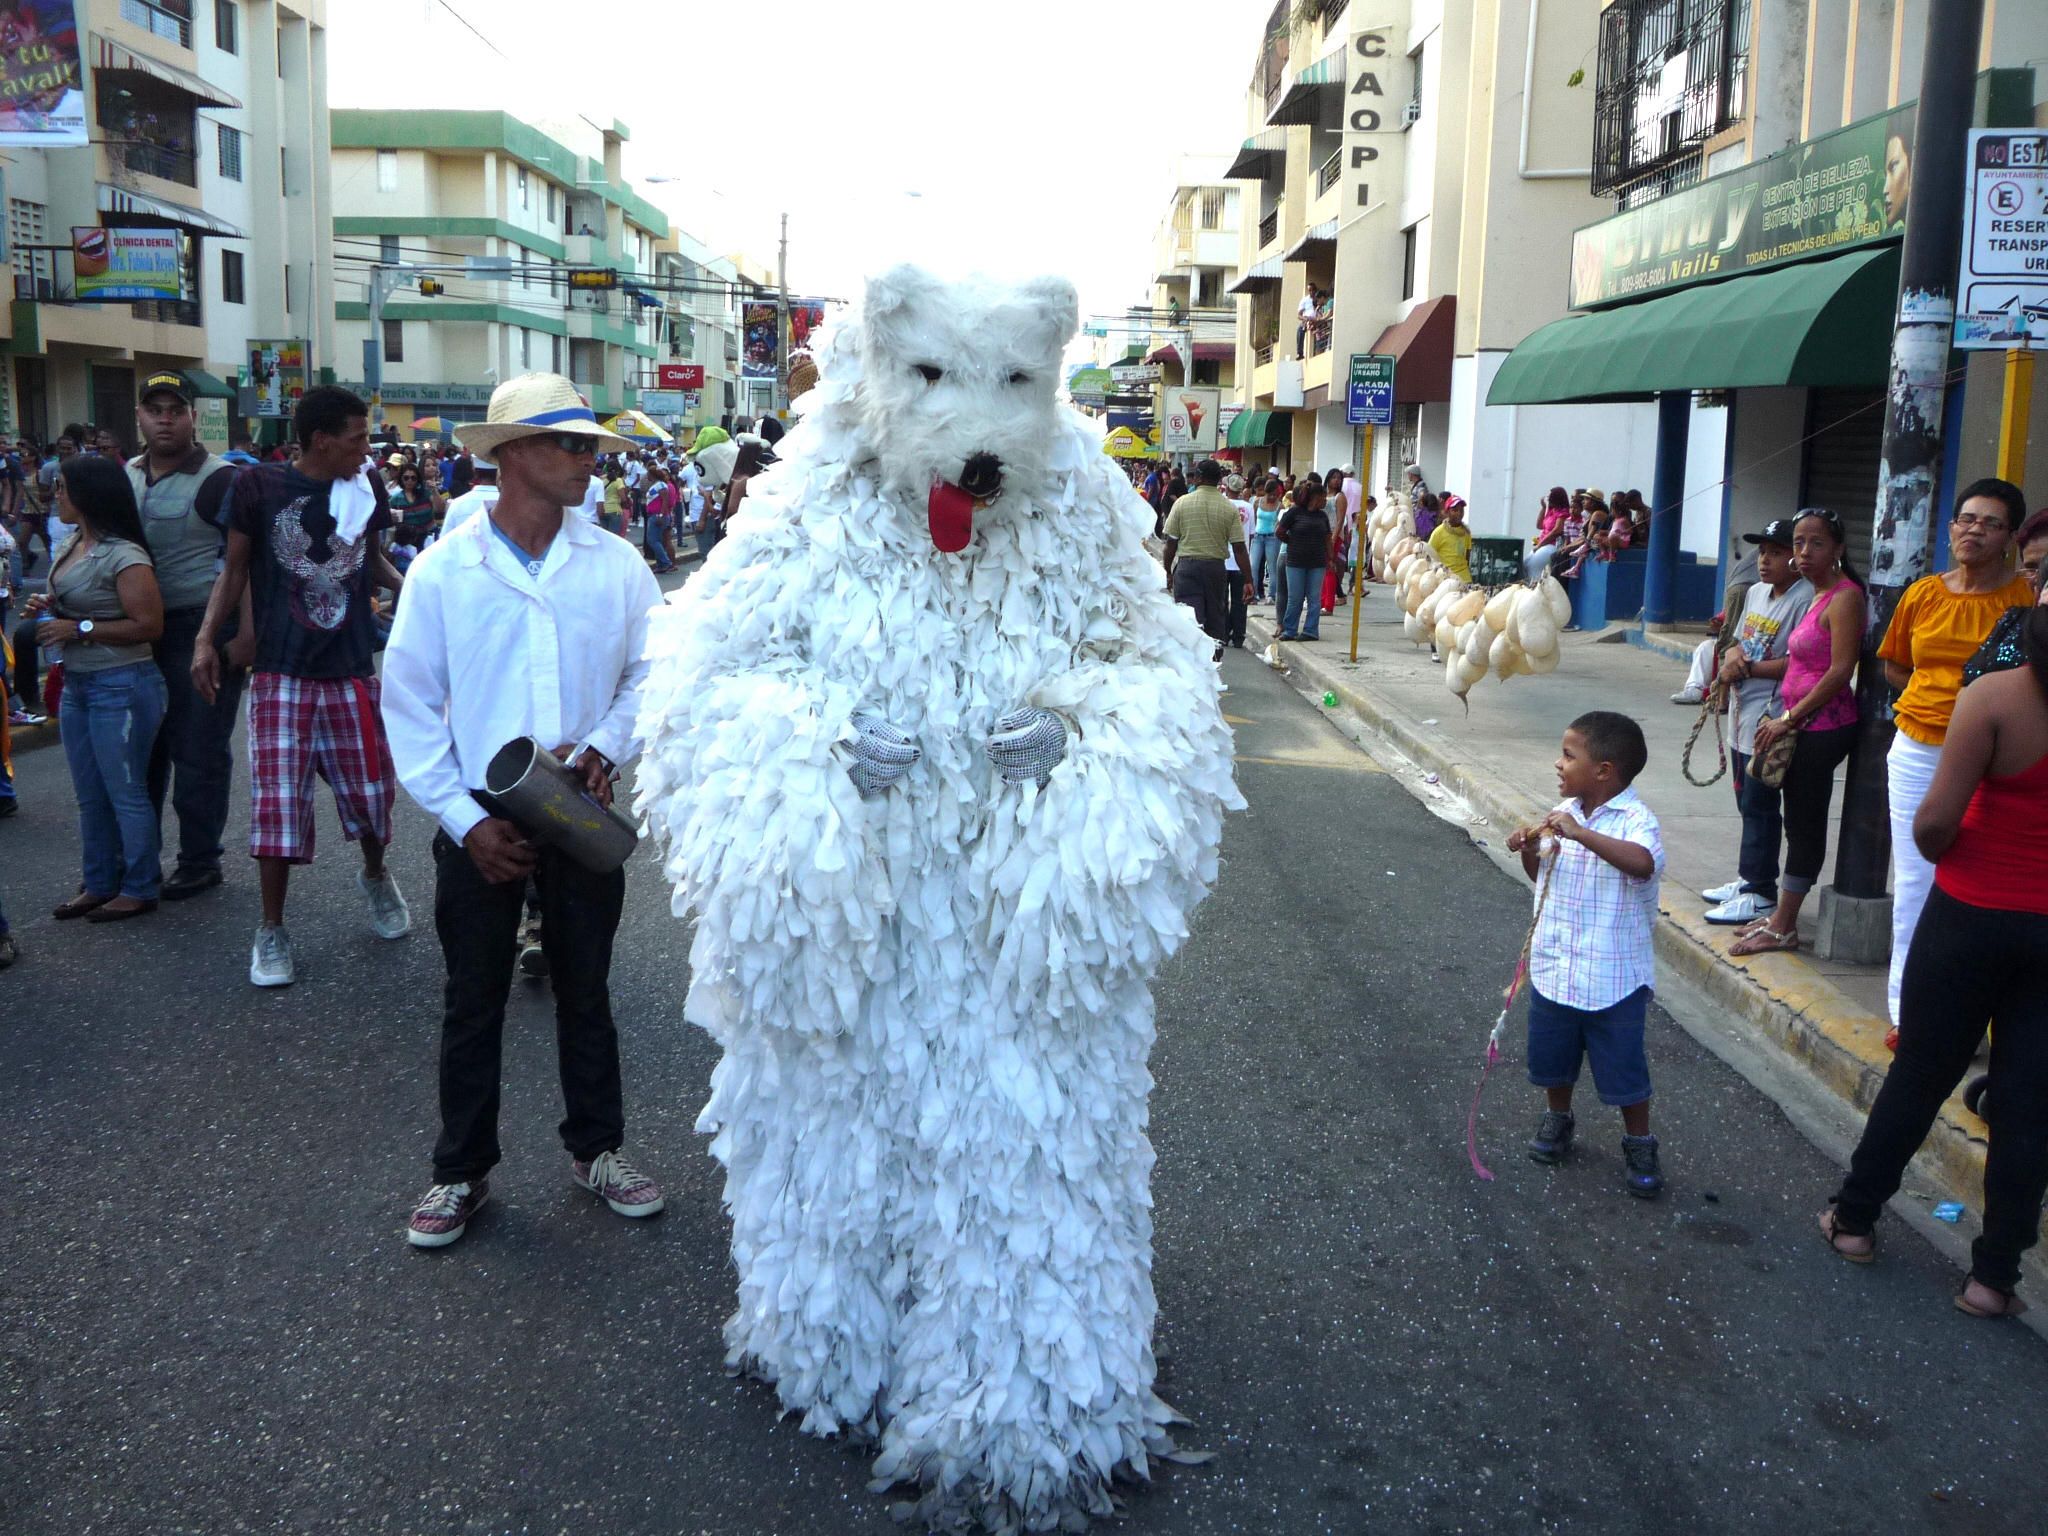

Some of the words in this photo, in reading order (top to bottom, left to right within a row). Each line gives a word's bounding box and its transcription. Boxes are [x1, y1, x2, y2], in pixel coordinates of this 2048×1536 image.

[1350, 34, 1386, 206] CAOPI
[1984, 144, 2008, 163] NO
[1762, 178, 1803, 208] CENTRO
[1804, 171, 1819, 195] DE
[1820, 154, 1871, 189] BELLEZA
[1819, 190, 1836, 215] DE
[1836, 182, 1868, 211] PELO
[113, 236, 145, 247] CLÍNICA
[146, 237, 175, 248] DENTAL
[1746, 249, 1768, 265] TODAS
[1768, 247, 1778, 260] LA
[1780, 234, 1815, 256] TECNICAS
[1815, 233, 1827, 247] DE
[1851, 225, 1858, 240] Y
[1857, 219, 1880, 239] PELO
[1668, 251, 1721, 281] Nails
[667, 370, 690, 379] Claro
[352, 386, 416, 398] Cooerativa
[421, 388, 440, 399] San
[1366, 395, 1374, 407] K
